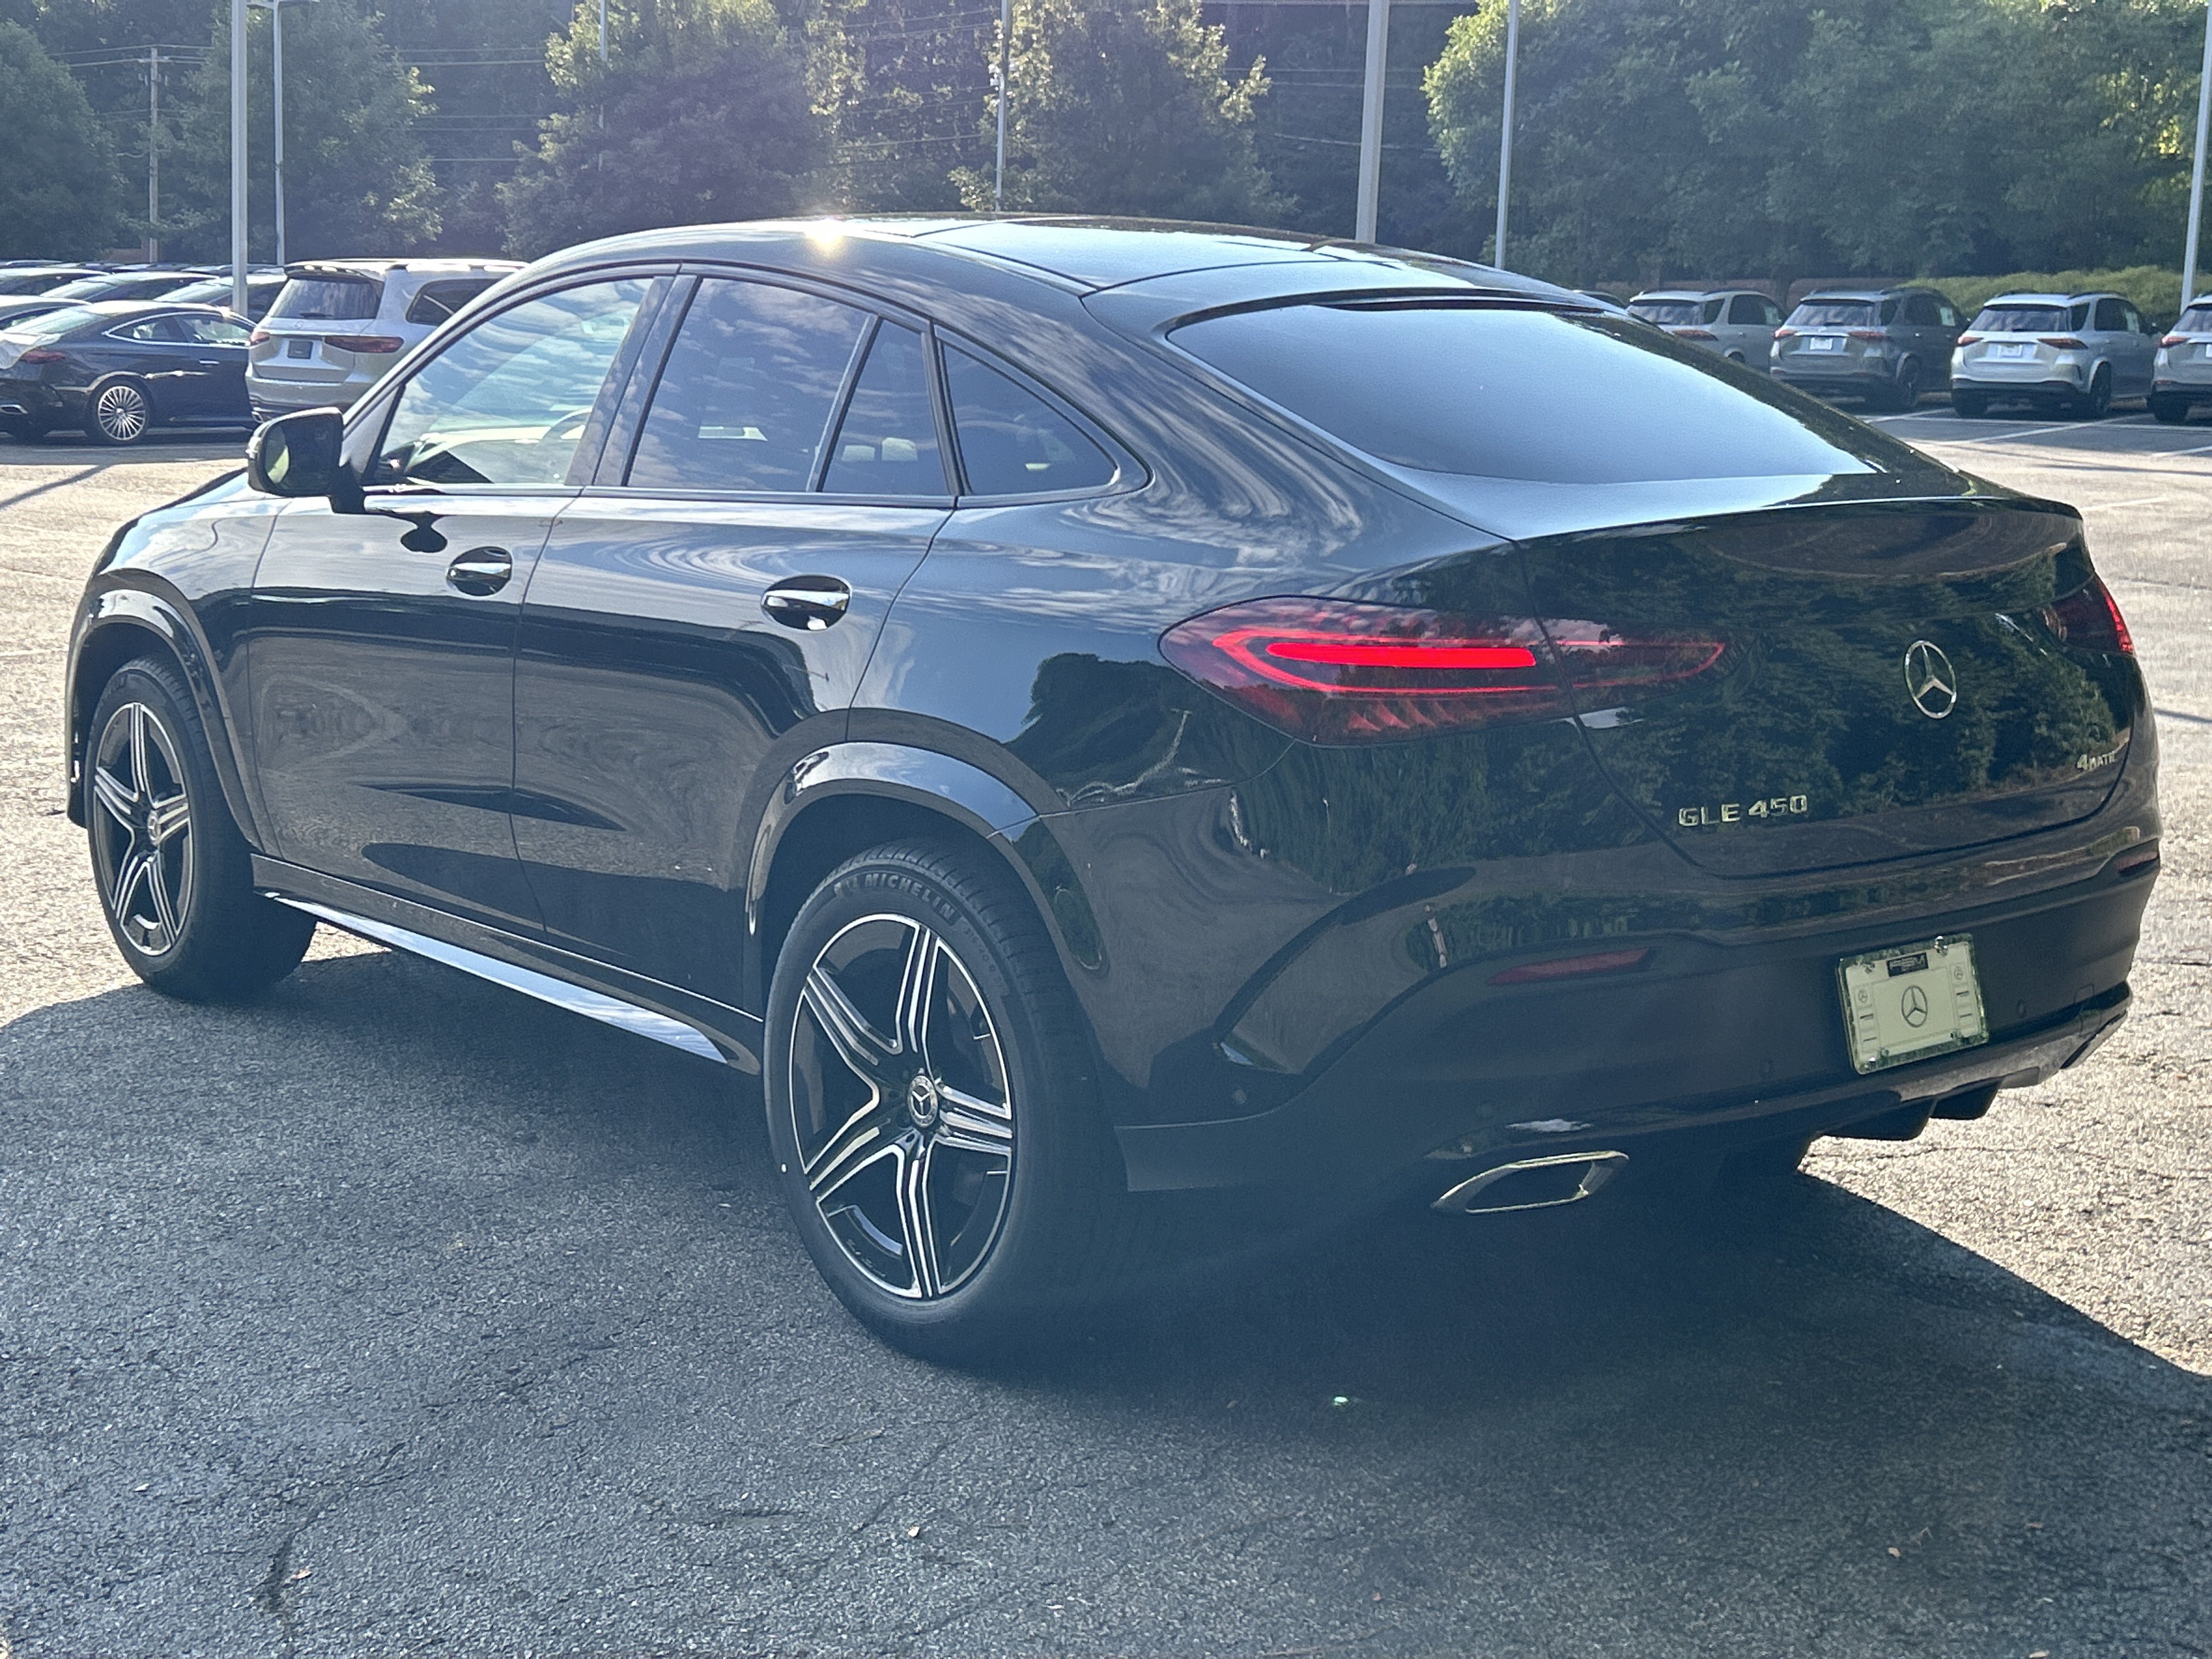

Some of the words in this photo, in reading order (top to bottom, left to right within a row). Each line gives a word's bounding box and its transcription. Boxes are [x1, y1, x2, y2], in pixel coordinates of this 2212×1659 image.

[1678, 803, 1741, 826] GLE
[1748, 794, 1808, 819] 450
[864, 873, 956, 921] MICHELIN
